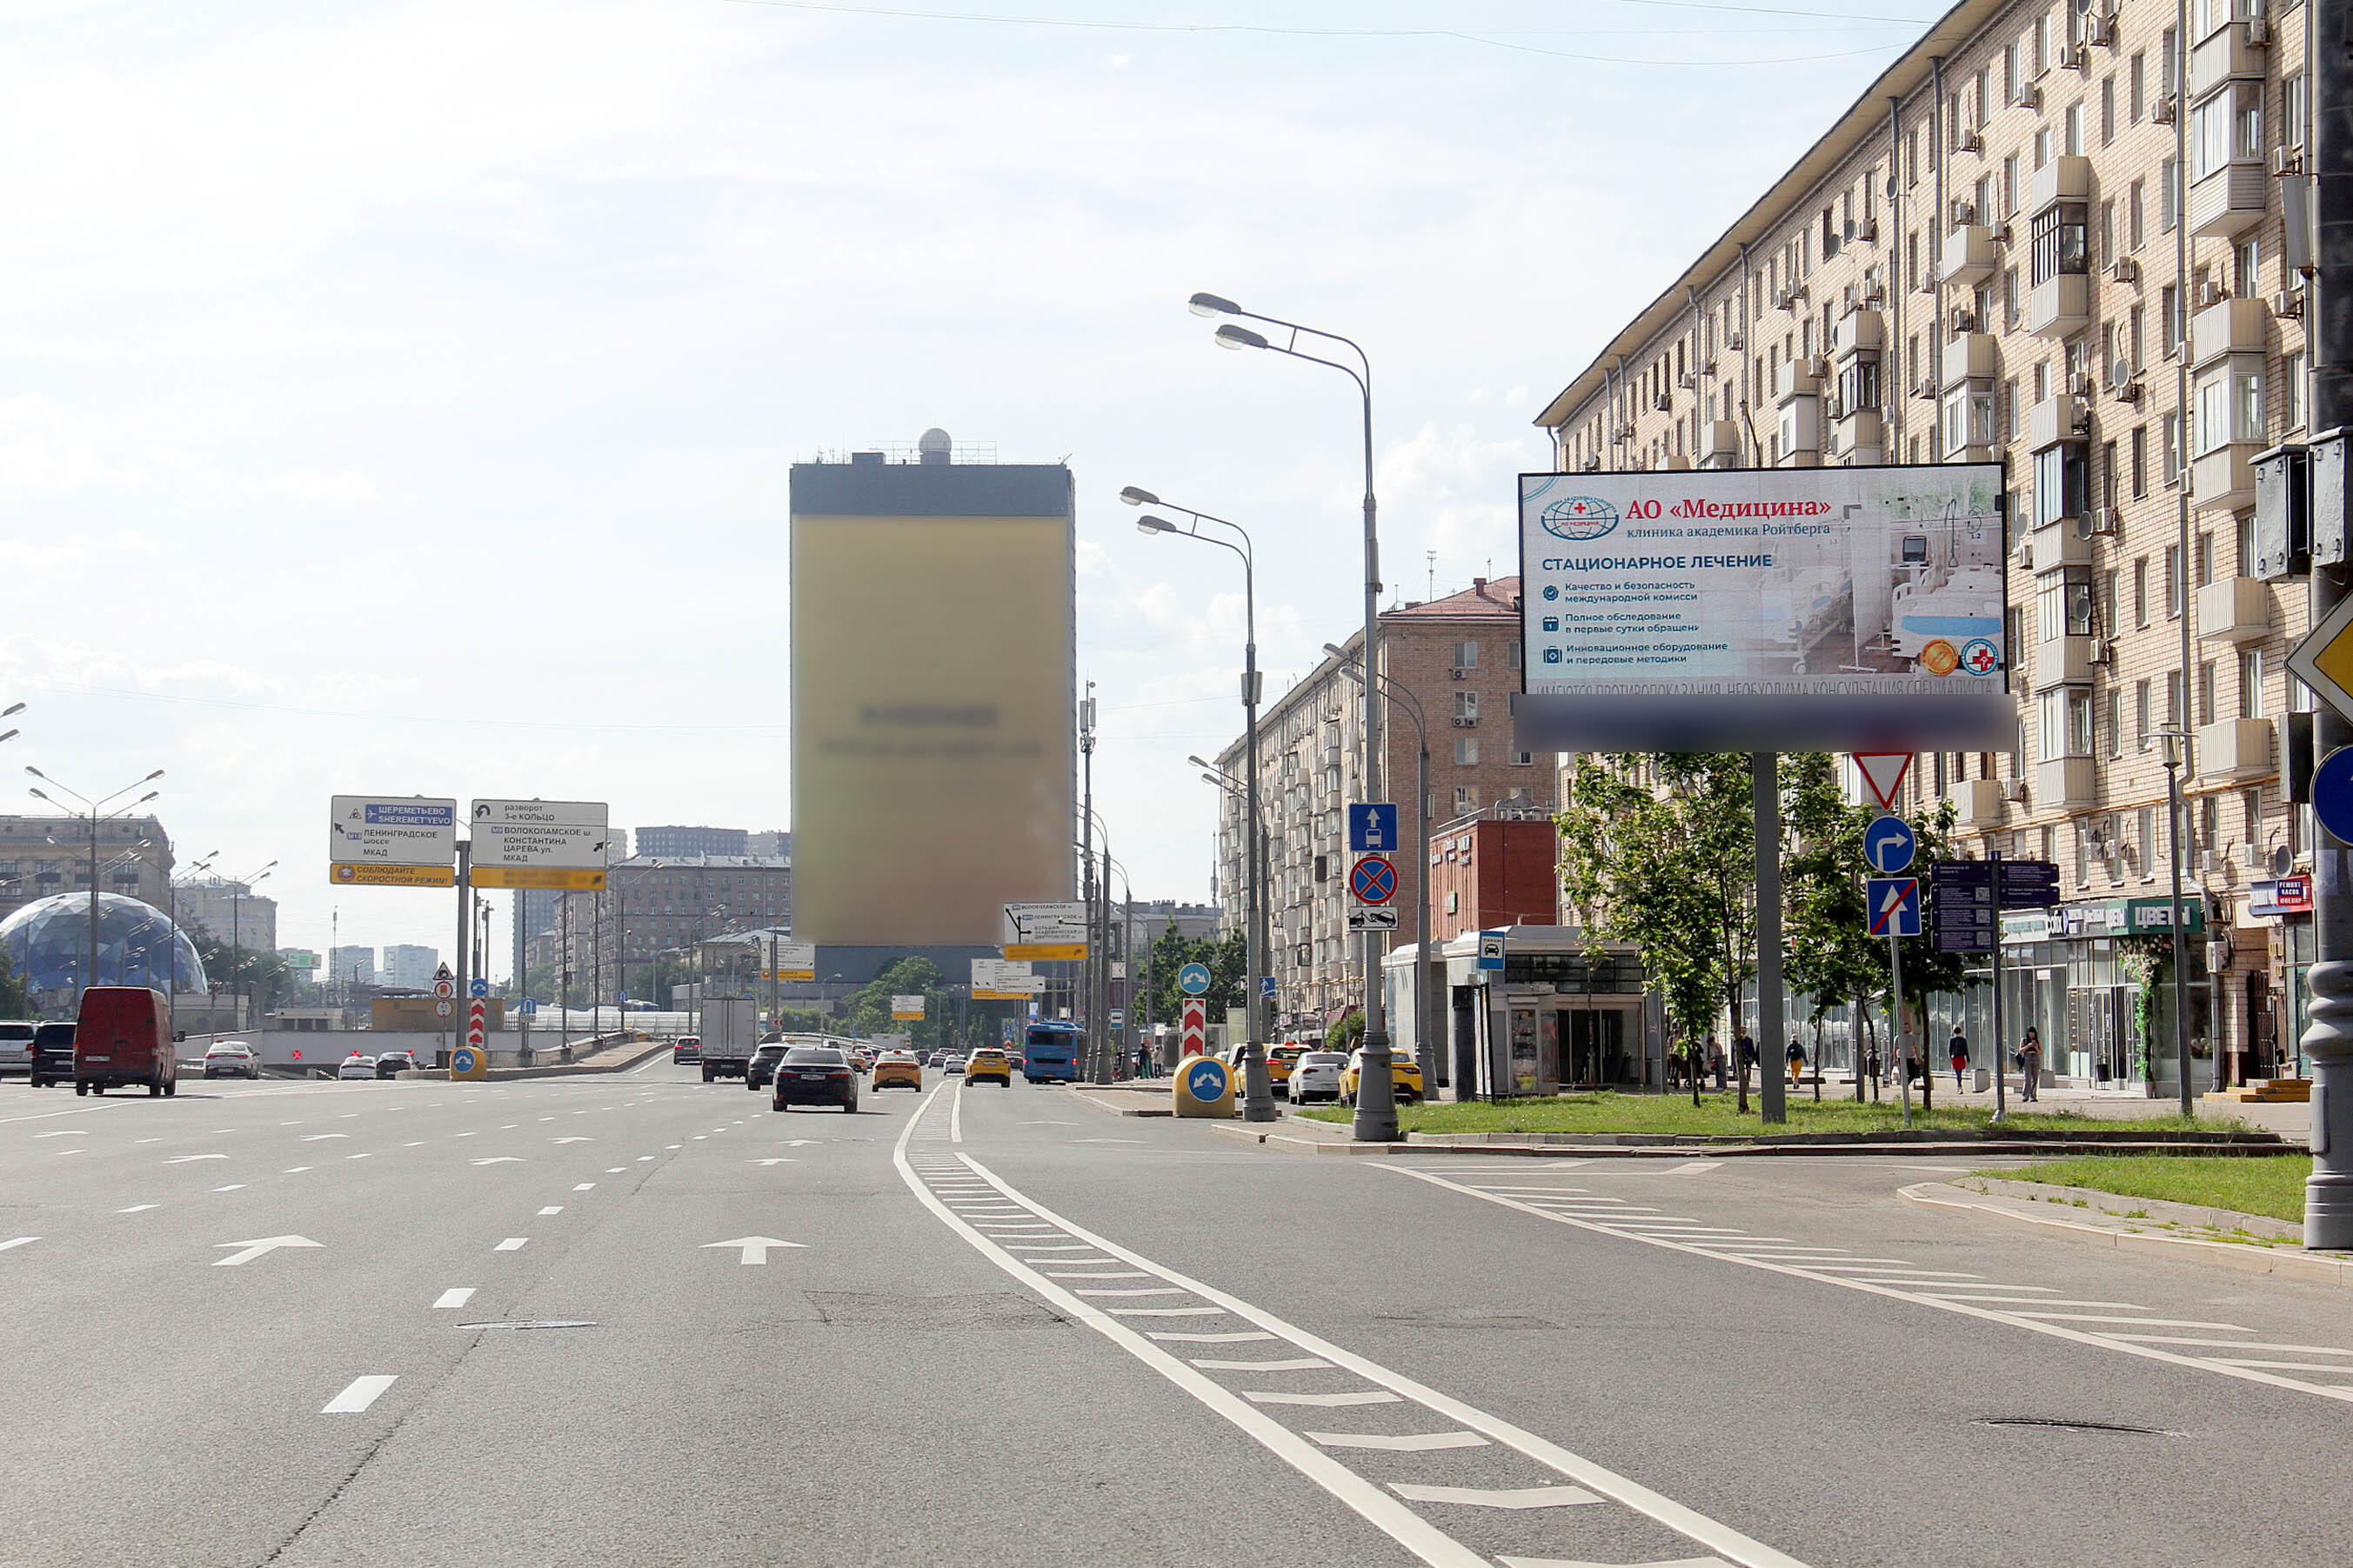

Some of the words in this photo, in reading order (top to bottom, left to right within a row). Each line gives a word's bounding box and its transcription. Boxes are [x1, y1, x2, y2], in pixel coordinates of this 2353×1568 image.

[1626, 499, 1661, 520] АО
[1670, 499, 1831, 521] «Медицина»
[1628, 527, 1683, 538] клиника
[1687, 526, 1758, 537] академика
[1762, 523, 1830, 537] Ройтберга
[1542, 557, 1686, 572] СТАЦИОНАРНОЕ
[1691, 554, 1773, 568] ЛЕЧЕНИЕ
[1566, 583, 1612, 591] Качество
[1624, 582, 1695, 591] безопасность
[1566, 593, 1650, 604] международной
[1566, 613, 1604, 622] Полное
[1607, 612, 1681, 621] обследование
[1574, 626, 1613, 635] первые
[1615, 625, 1645, 635] сутки
[1567, 644, 1650, 653] Инновационное
[1653, 642, 1728, 653] оборудование
[1576, 657, 1634, 665] передовые
[1636, 655, 1687, 664] методики
[378, 806, 445, 815] ШЕРЕМЕТЬЕВО
[364, 830, 438, 838] ЛЕНИНГРАДСКОЕ
[505, 827, 581, 836] ВОЛОКОЛАМСКОЕ
